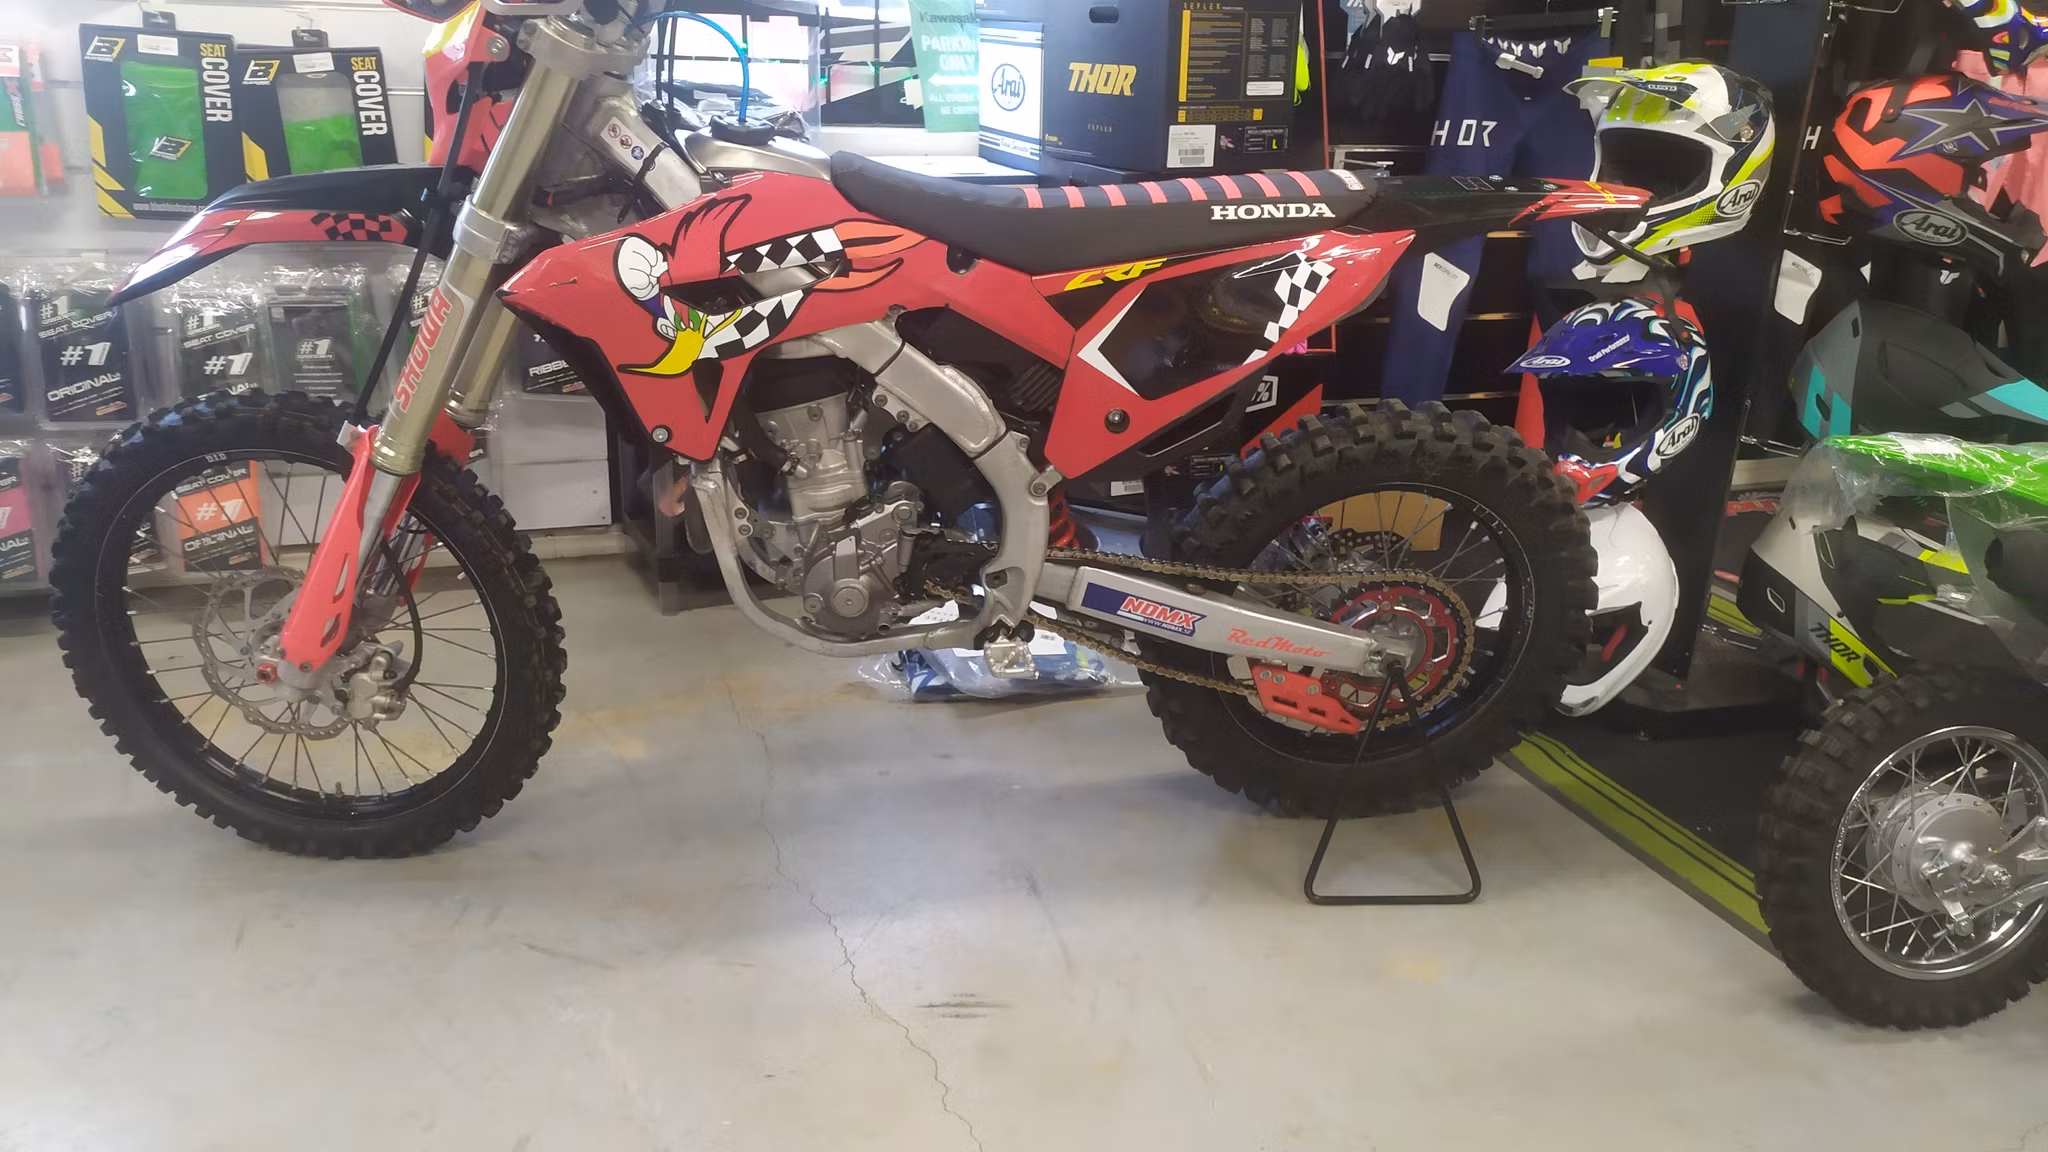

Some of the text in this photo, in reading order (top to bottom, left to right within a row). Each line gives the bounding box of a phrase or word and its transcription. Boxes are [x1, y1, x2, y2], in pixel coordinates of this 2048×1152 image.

[919, 12, 979, 23] Kawasak
[200, 43, 227, 58] SEAT
[921, 34, 978, 52] PARKIN
[351, 57, 377, 71] SEAT
[201, 57, 233, 122] COVER
[992, 66, 1023, 99] Arai
[1068, 62, 1137, 96] THOR
[353, 70, 388, 136] COVER
[1721, 184, 1758, 210] Arai
[1211, 203, 1336, 220] HONDA
[1900, 214, 1960, 239] Arai
[1064, 257, 1168, 291] CRF
[38, 324, 69, 339] SEAT
[183, 322, 256, 349] SEAT COVER
[60, 342, 111, 366] #1
[299, 339, 330, 355] #1
[393, 287, 452, 413] SHOWA
[204, 352, 254, 375] #1
[1660, 417, 1694, 454] Arai
[175, 480, 205, 494] SEAT
[195, 499, 244, 520] #1
[1122, 595, 1201, 630] NDMX
[1808, 622, 1862, 664] THOR
